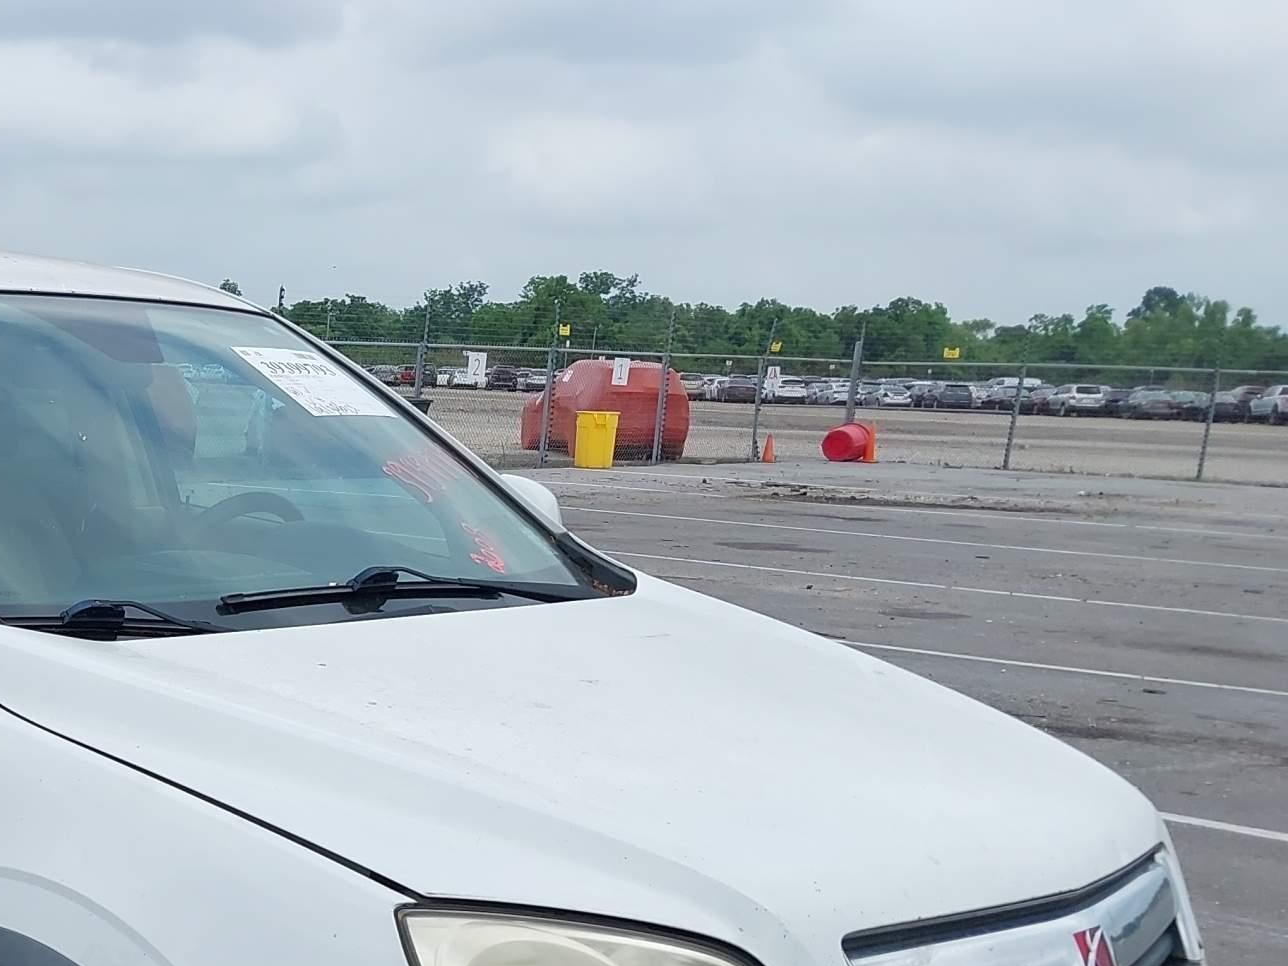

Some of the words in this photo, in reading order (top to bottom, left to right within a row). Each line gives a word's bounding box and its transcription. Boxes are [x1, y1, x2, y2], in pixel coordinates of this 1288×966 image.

[260, 361, 337, 376] 39399793
[473, 358, 481, 376] 2
[617, 363, 624, 380] 1
